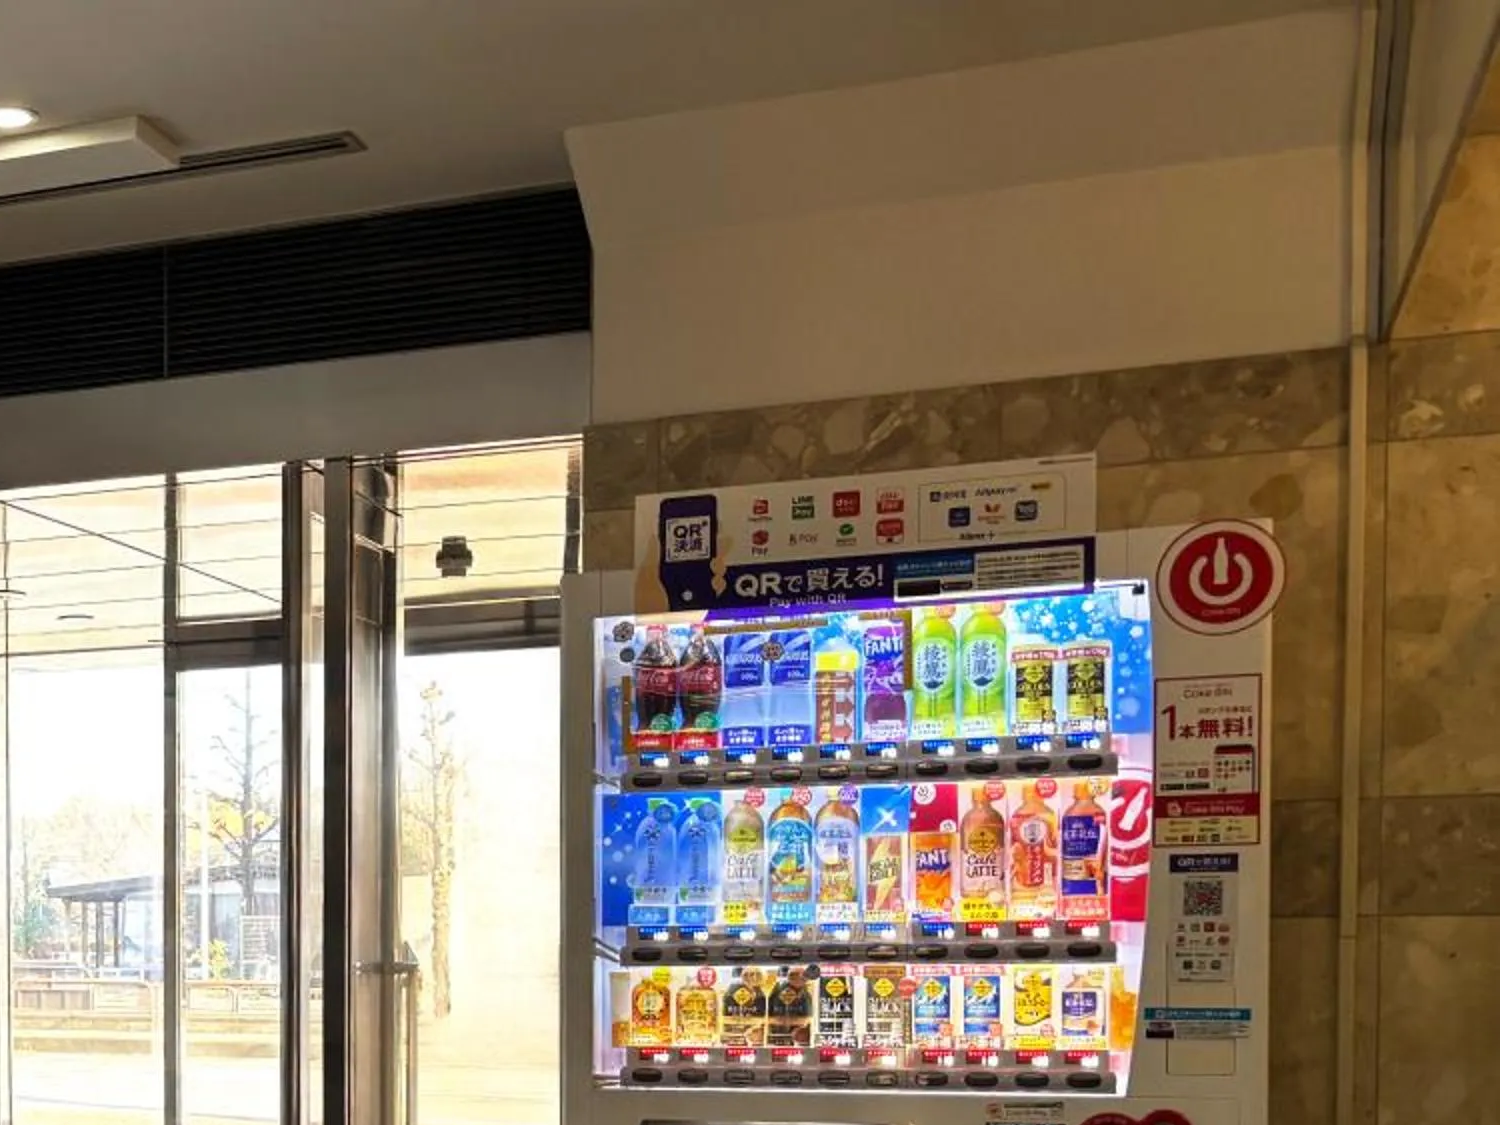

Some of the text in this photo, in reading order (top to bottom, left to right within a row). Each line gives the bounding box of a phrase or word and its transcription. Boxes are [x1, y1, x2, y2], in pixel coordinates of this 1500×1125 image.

[673, 525, 702, 539] QR
[734, 563, 884, 597] QRで買える!
[770, 594, 847, 610] Pay with QR
[865, 635, 903, 654] FANT
[1161, 703, 1253, 741] 1本無料!
[916, 849, 950, 867] FANT
[966, 865, 999, 879] LATTE
